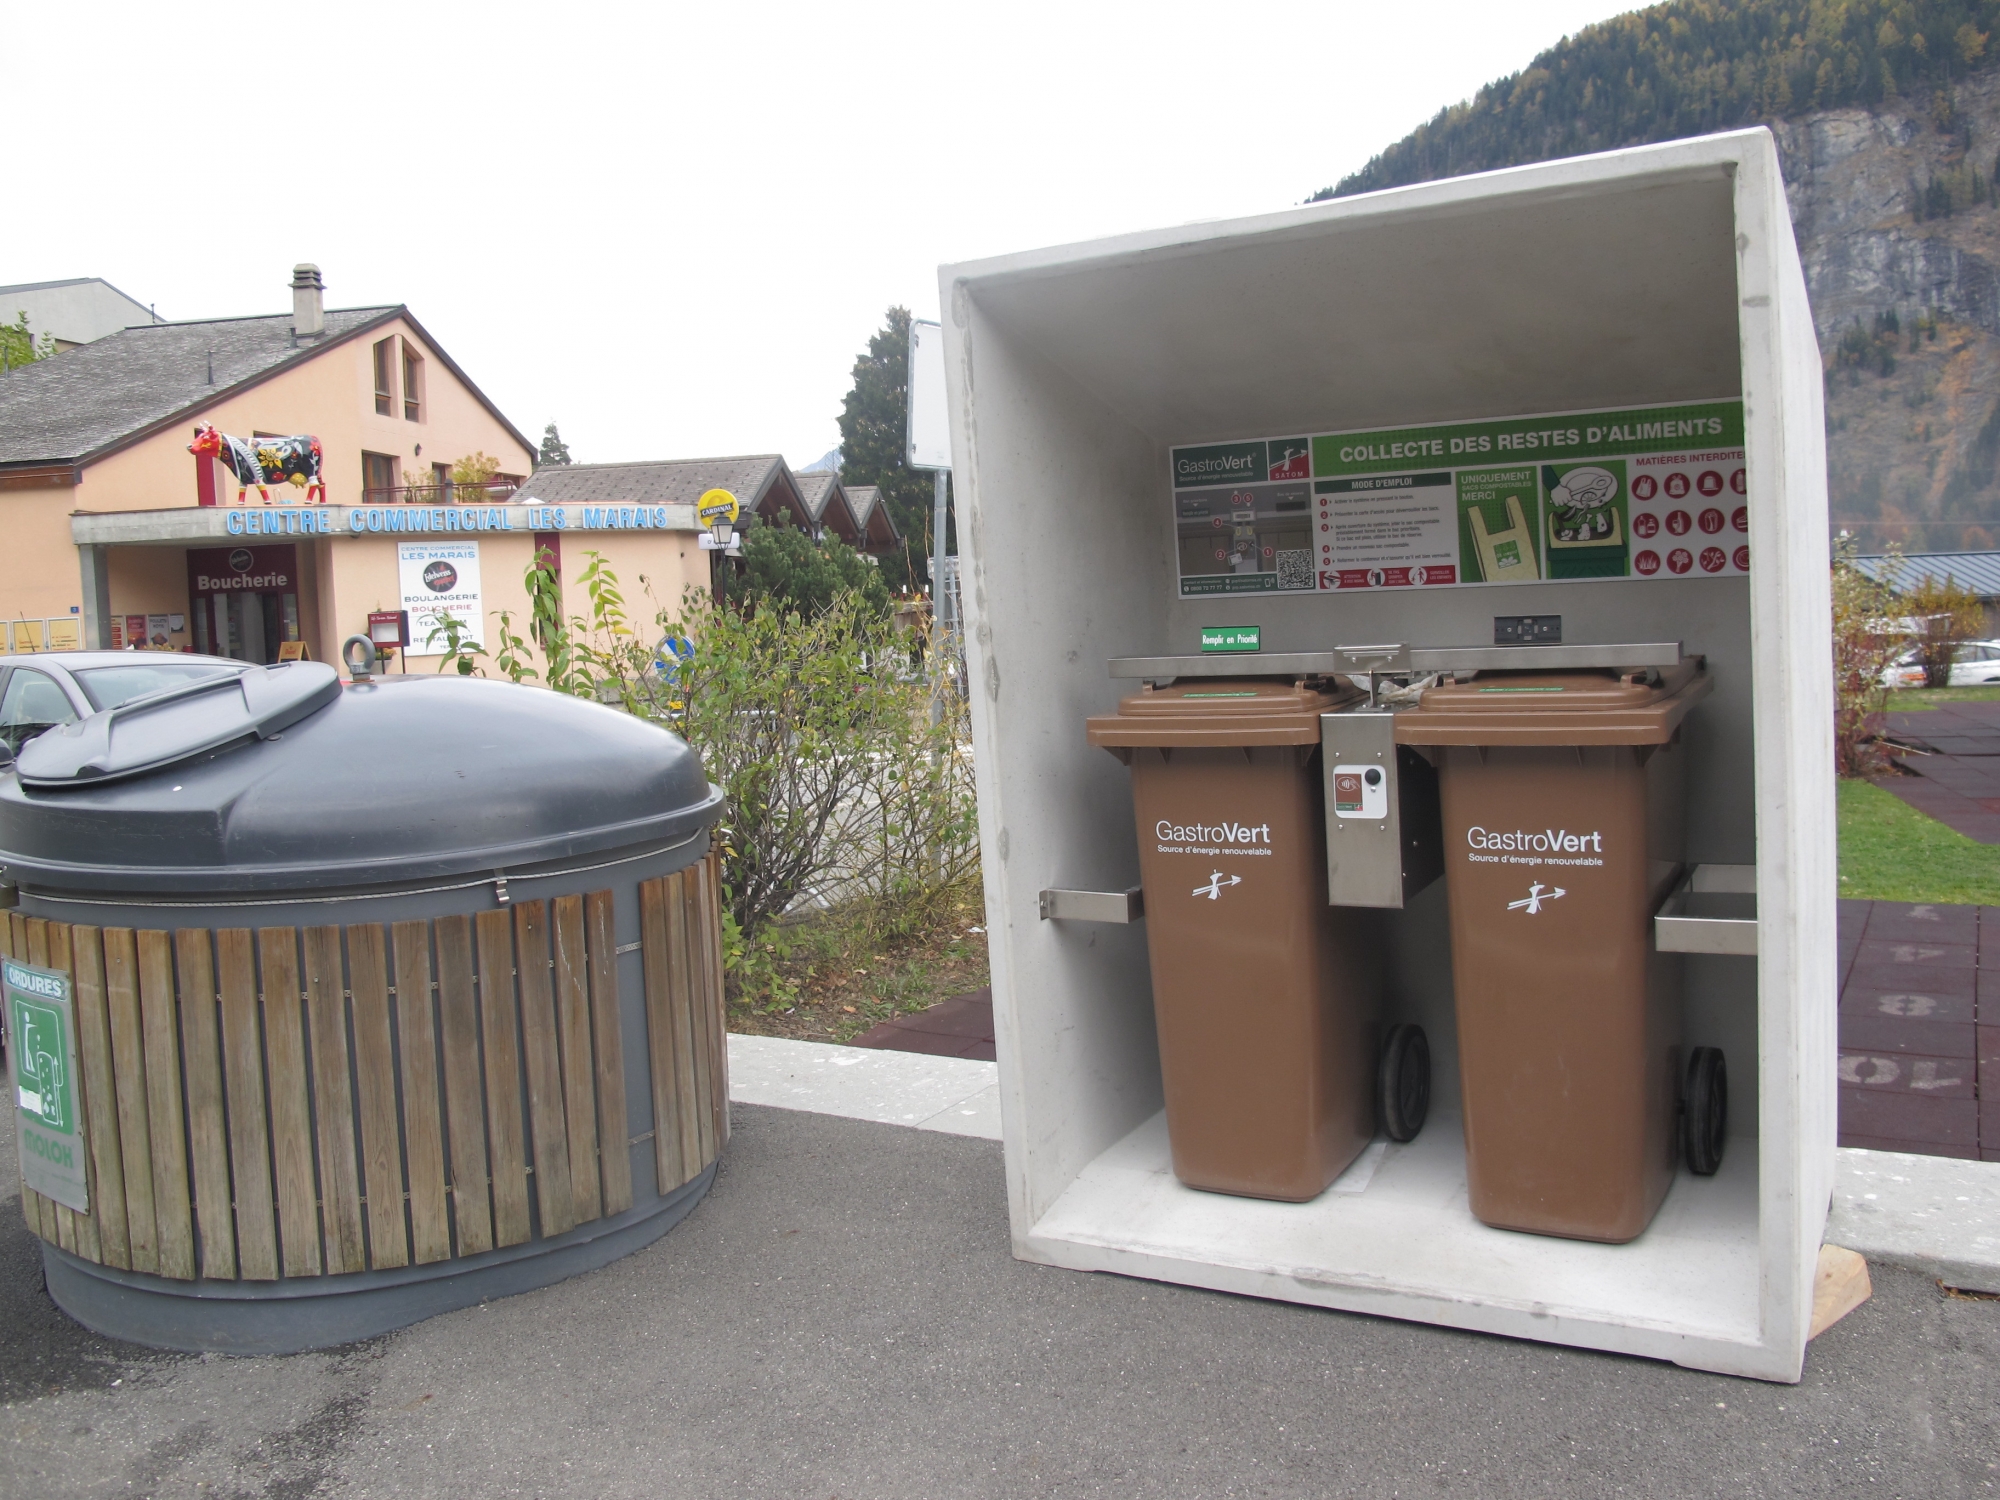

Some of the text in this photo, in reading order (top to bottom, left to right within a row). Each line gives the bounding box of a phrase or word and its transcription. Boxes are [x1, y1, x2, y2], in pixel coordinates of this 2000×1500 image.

[1340, 418, 1722, 462] COLLECTE DES RESTES D'ALIMENTS
[1636, 451, 1744, 466] MATIÈRES INTERDITE
[1352, 477, 1413, 490] MODE D'EMPLOI
[1460, 471, 1532, 484] UNIQUEMENT
[1480, 481, 1532, 490] COMPOSTABLES
[1462, 491, 1496, 501] MERCI
[702, 504, 732, 516] CARDINAL
[227, 508, 668, 535] CENTRE COMMERCIAL LES MARAIS
[198, 572, 288, 590] Boucherie
[404, 594, 478, 602] BOULANGERIE
[412, 604, 472, 613] BOUCHERIE
[1202, 634, 1224, 646] Remplir
[1237, 634, 1258, 644] Priorité
[1156, 820, 1270, 843] GastroVert
[1467, 826, 1602, 853] GastroVert
[1158, 844, 1272, 856] Source d'énergie renouvelable
[1468, 853, 1603, 866] Source d'énergie renouvelable
[8, 966, 62, 998] ORDURES
